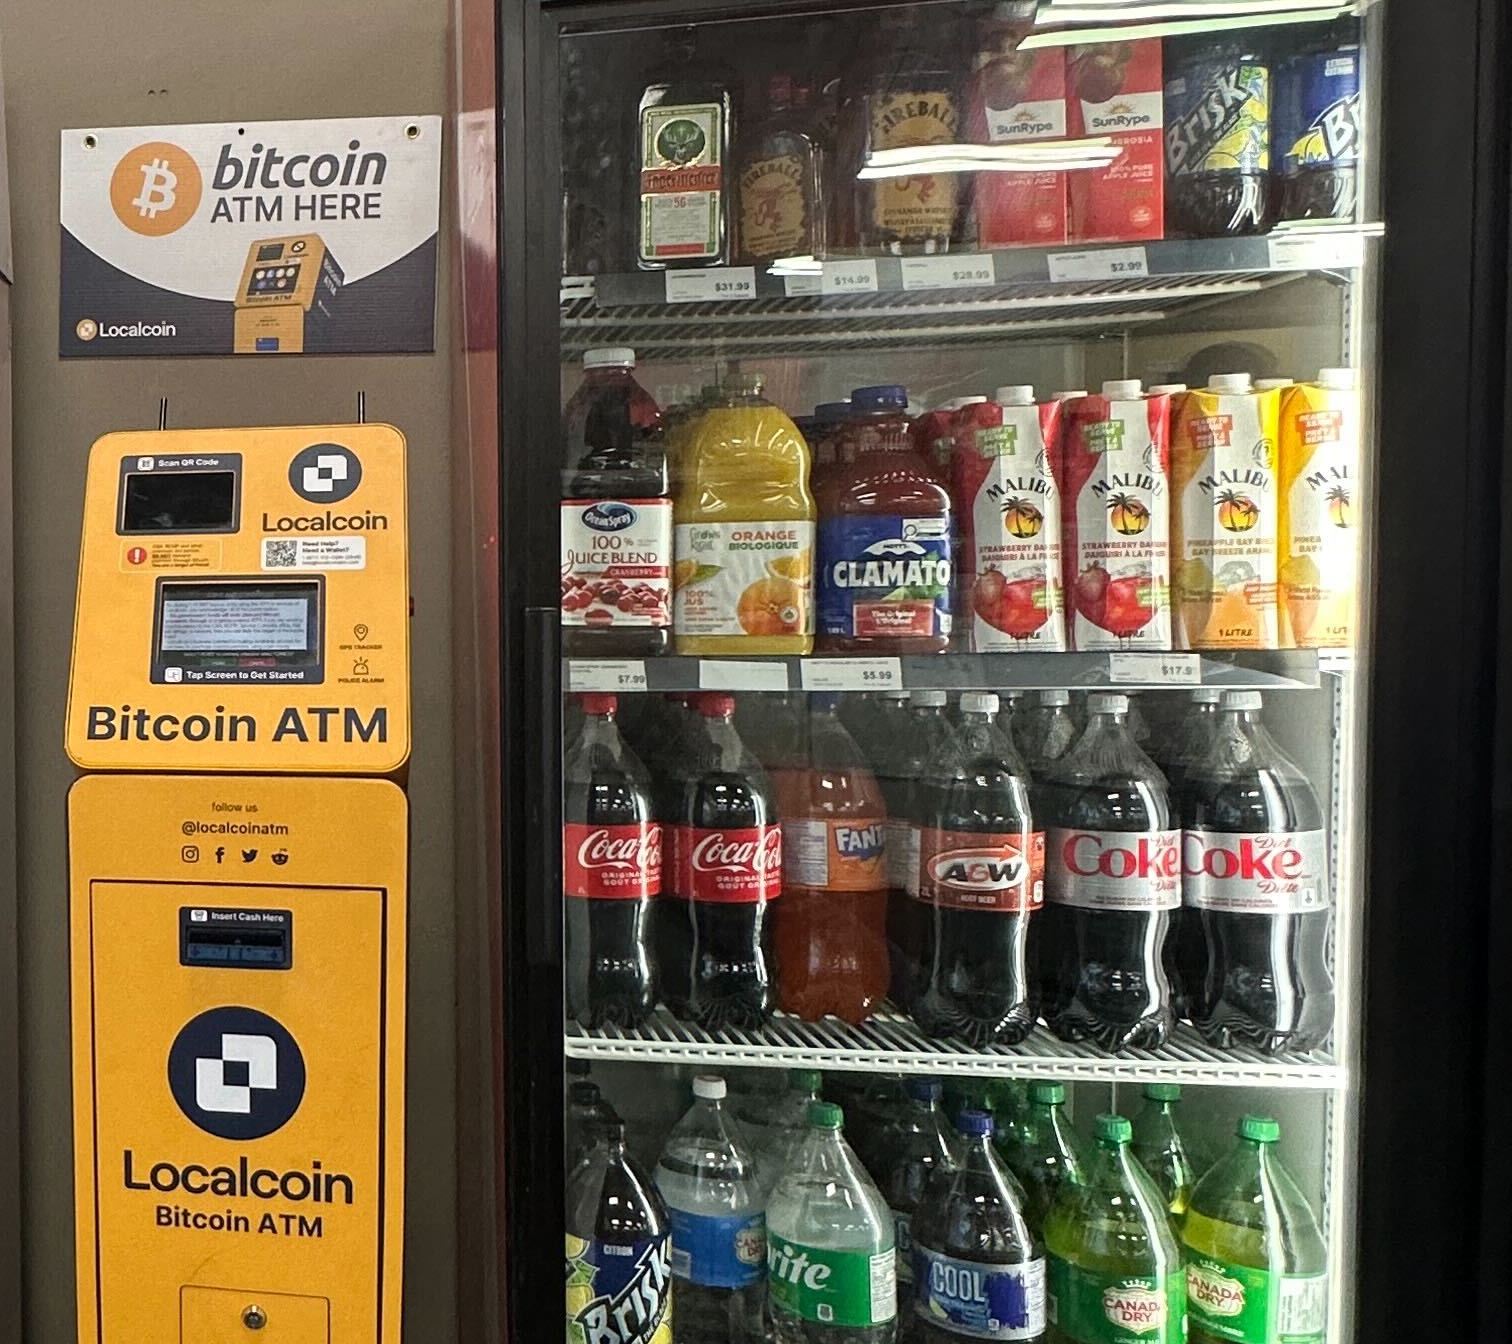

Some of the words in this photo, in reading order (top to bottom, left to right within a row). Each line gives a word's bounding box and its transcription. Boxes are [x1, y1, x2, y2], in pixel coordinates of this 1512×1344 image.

[997, 122, 1053, 134] SunRype
[1092, 114, 1151, 128] SunRype
[1113, 135, 1153, 145] BROSIA
[212, 140, 387, 190] bitcoin
[211, 195, 283, 223] ATM
[294, 193, 381, 221] HERE
[100, 320, 177, 338] Localcoin
[158, 458, 180, 468] Scan
[195, 457, 219, 467] Code
[985, 476, 1055, 504] MALIBU
[1091, 472, 1164, 499] MALIBU
[1198, 469, 1270, 496] MALIBU
[262, 510, 388, 533] Localcoin
[728, 541, 799, 551] BIOLOGIQUE
[731, 530, 797, 542] ORANGE
[562, 549, 609, 575] JUICE
[611, 552, 658, 564] BLEND
[833, 559, 951, 589] CLAMATO
[186, 670, 203, 680] Tap
[204, 670, 238, 680] Screen
[238, 671, 248, 680] to
[249, 670, 267, 680] Get
[269, 670, 304, 680] Started
[87, 705, 256, 743] Bitcoin
[271, 707, 388, 743] ATM
[211, 801, 243, 813] follow
[245, 803, 259, 813] us
[181, 820, 289, 836] @localcoinatm
[1063, 833, 1180, 879] Coke
[940, 862, 1022, 883] A&W
[211, 911, 237, 921] Insert
[238, 912, 261, 922] Cash
[262, 913, 284, 923] Here
[123, 1149, 353, 1205] Localcoin
[155, 1205, 250, 1233] Bitcoin
[257, 1212, 324, 1238] ATM
[767, 1244, 832, 1291] rite
[932, 1261, 986, 1304] COOL
[1196, 1289, 1225, 1307] DRY
[1122, 1310, 1152, 1324] DRY
